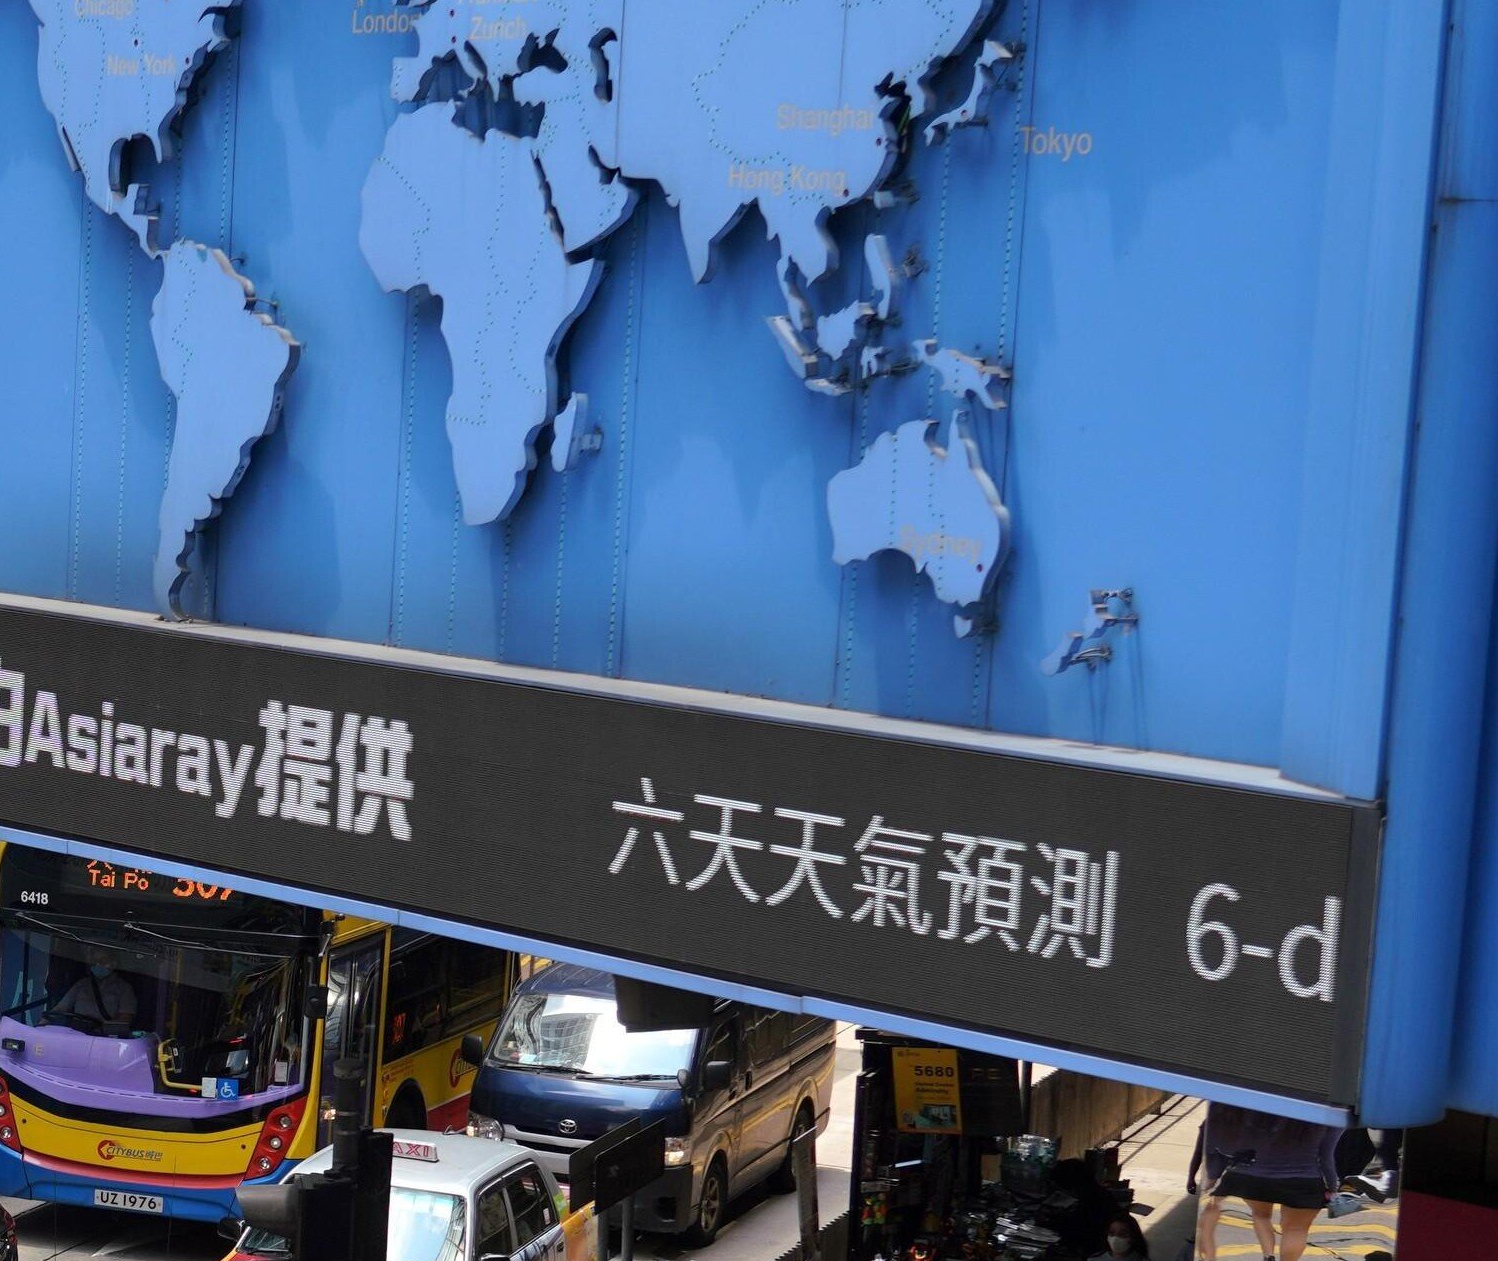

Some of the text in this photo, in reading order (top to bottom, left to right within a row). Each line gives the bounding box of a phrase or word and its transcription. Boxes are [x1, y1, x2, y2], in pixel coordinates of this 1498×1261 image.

[470, 14, 527, 41] Zurich
[106, 54, 177, 76] New York
[776, 103, 875, 137] Shanghai
[1020, 127, 1092, 161] Tokyo
[727, 163, 846, 196] Hong Kong
[900, 525, 983, 563] Sydney
[88, 869, 149, 891] Tai Po
[607, 775, 1341, 1003] 六天天氣預測 6-d
[20, 890, 49, 906] 6418
[914, 1065, 955, 1078] 5680
[106, 1146, 146, 1158] CITYBUS
[392, 1141, 430, 1158] AXI
[100, 1191, 157, 1210] UZ 1976
